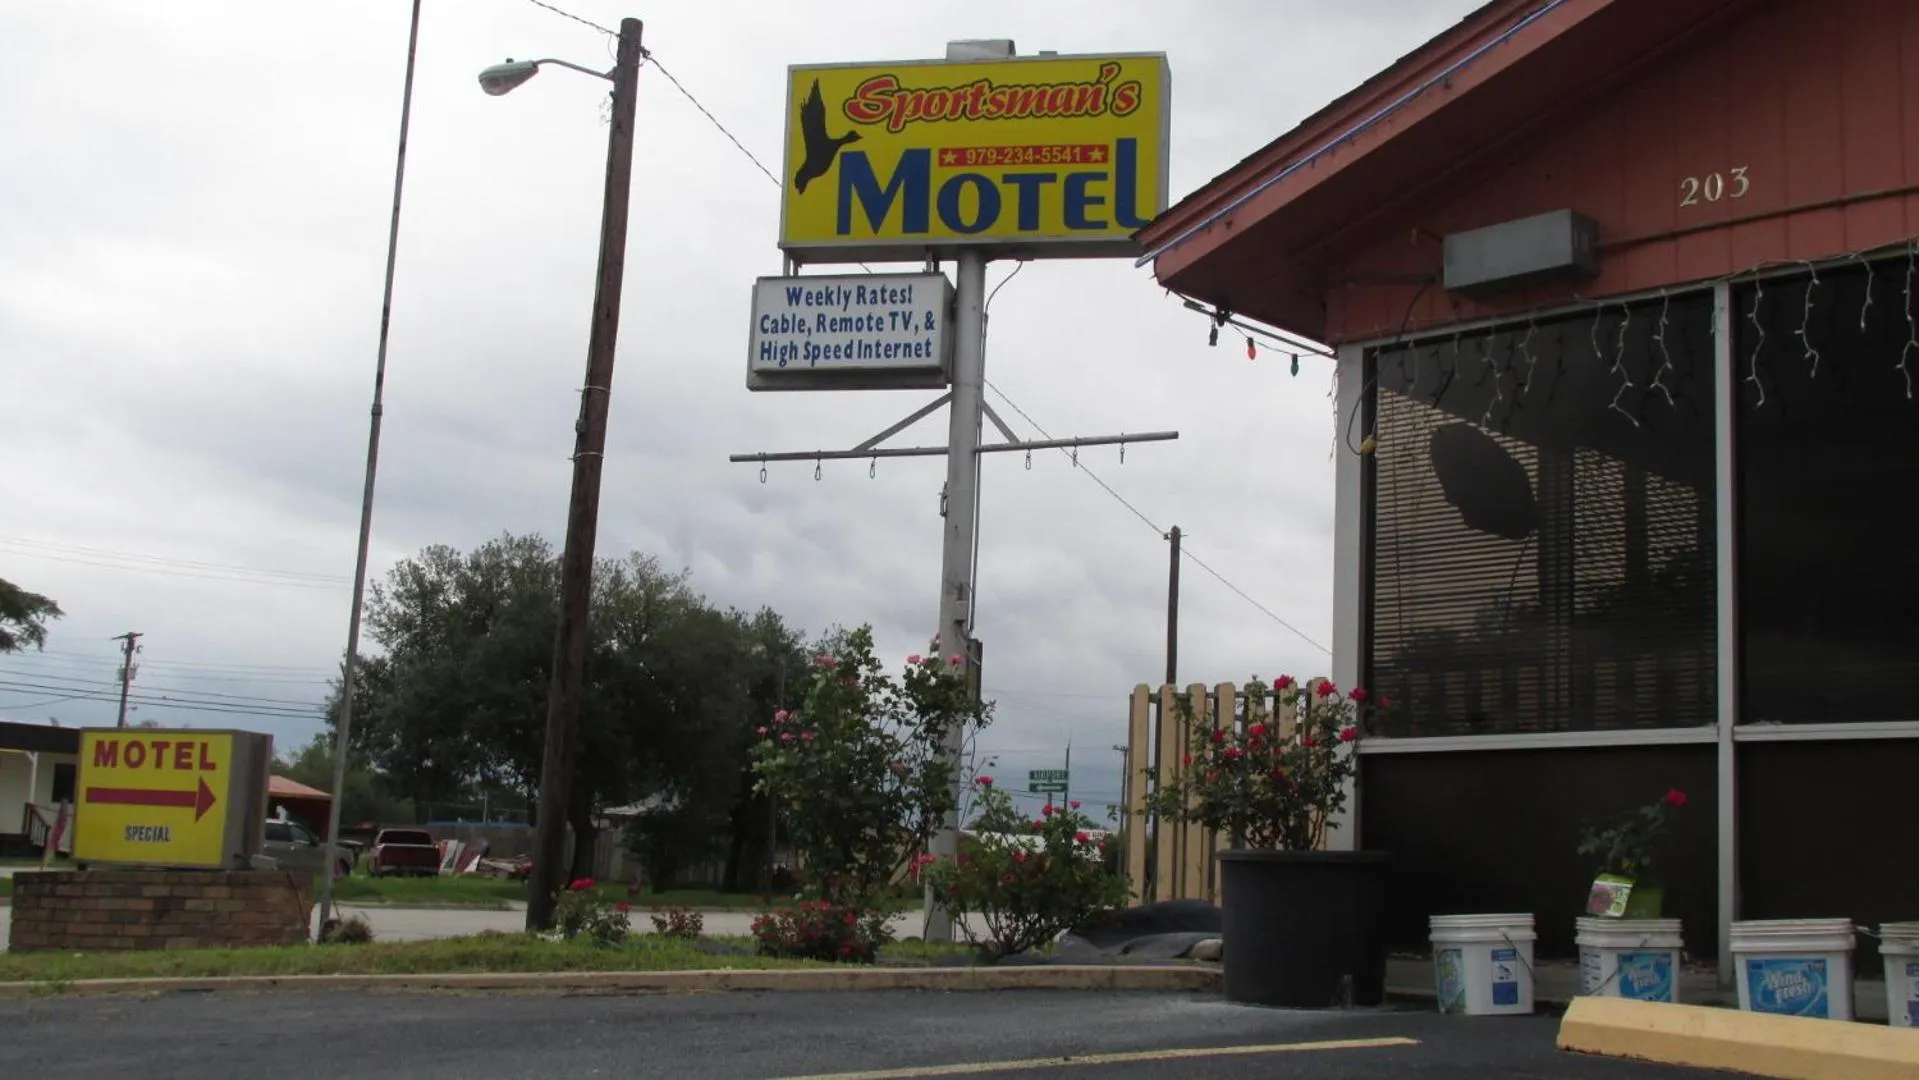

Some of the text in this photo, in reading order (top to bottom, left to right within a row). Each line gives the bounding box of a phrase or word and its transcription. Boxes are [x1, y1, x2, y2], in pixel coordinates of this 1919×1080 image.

[843, 62, 1142, 133] Sportsman's
[965, 145, 1082, 165] 979-234-5541
[1680, 165, 1750, 208] 203
[786, 284, 913, 312] Weekly Rates!
[760, 310, 936, 337] Cable, Remote TV, &
[760, 338, 932, 368] High Speed Internet
[93, 740, 217, 771] MOTEL
[124, 825, 171, 843] SPECIAL
